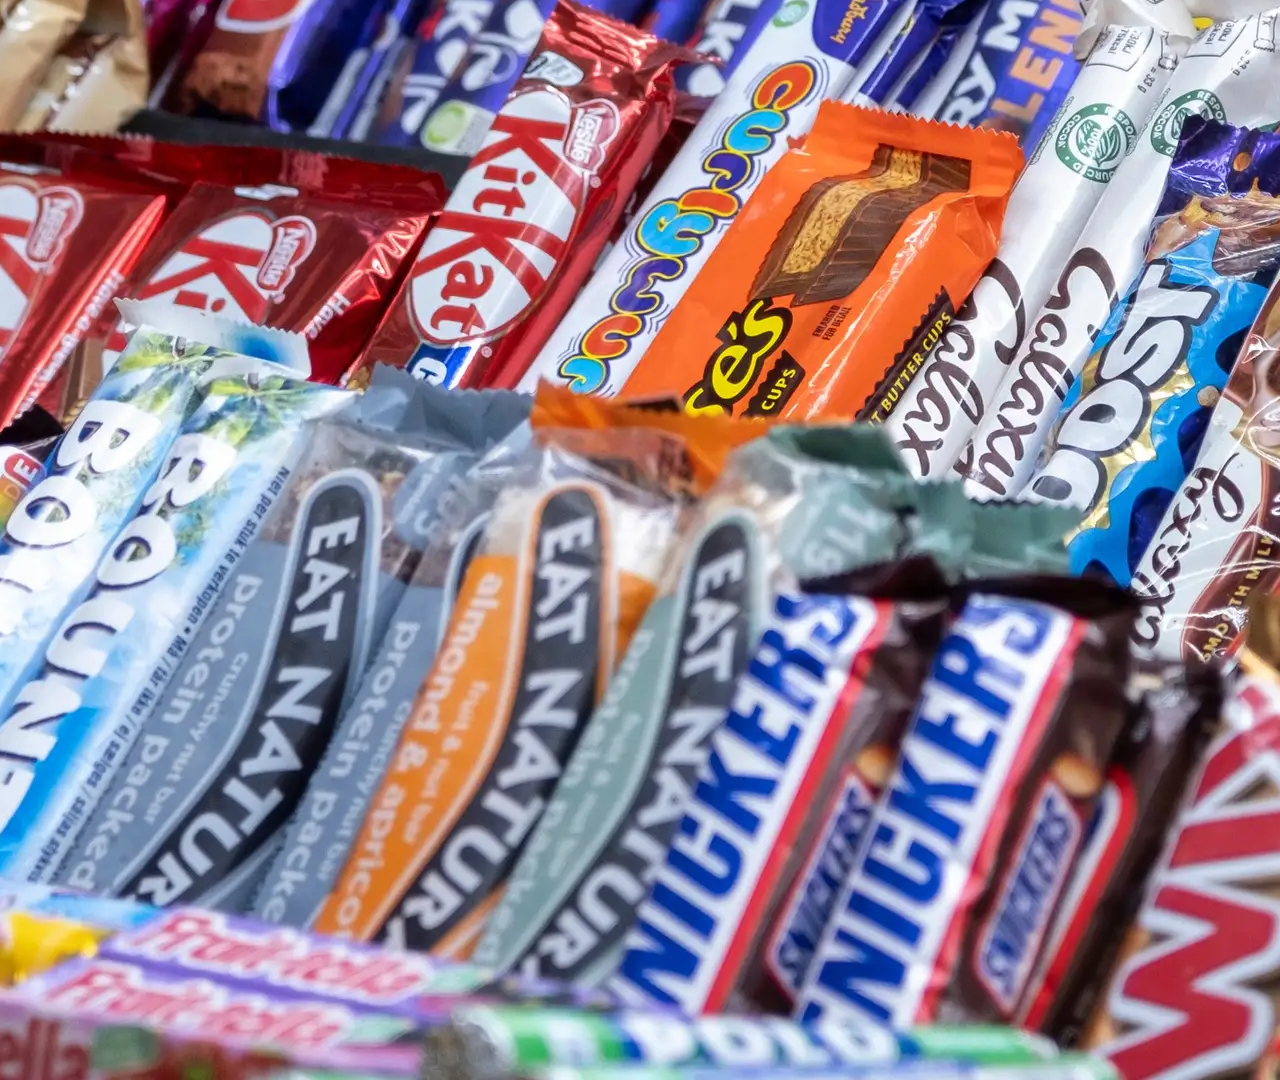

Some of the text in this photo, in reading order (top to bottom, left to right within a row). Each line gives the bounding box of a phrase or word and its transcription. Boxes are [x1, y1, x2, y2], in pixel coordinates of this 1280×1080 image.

[419, 108, 581, 338] KitKat
[759, 363, 798, 414] CUPS
[878, 311, 954, 412] BUTTER CUPS
[963, 247, 1118, 497] Galaxy
[9, 455, 39, 485] E
[232, 516, 262, 551] stuk
[249, 492, 274, 519] per
[223, 547, 242, 566] te
[533, 517, 595, 643] EAT
[182, 560, 234, 628] verkopen
[682, 549, 746, 683] EAT
[165, 634, 191, 661] Må
[409, 567, 508, 739] almond
[57, 567, 271, 897] protein packed
[111, 721, 135, 743] ej
[129, 685, 158, 719] ikke
[142, 515, 360, 907] EAT NATUR
[82, 737, 124, 790] sælges
[137, 647, 256, 828] crunchy nut bar
[392, 737, 431, 780] &
[255, 614, 426, 929] protein packe
[51, 793, 90, 840] säljas
[618, 594, 859, 1014] NICKERS
[817, 595, 1059, 1020] NICKERS
[22, 834, 65, 887] stykvis
[313, 836, 348, 885] bar
